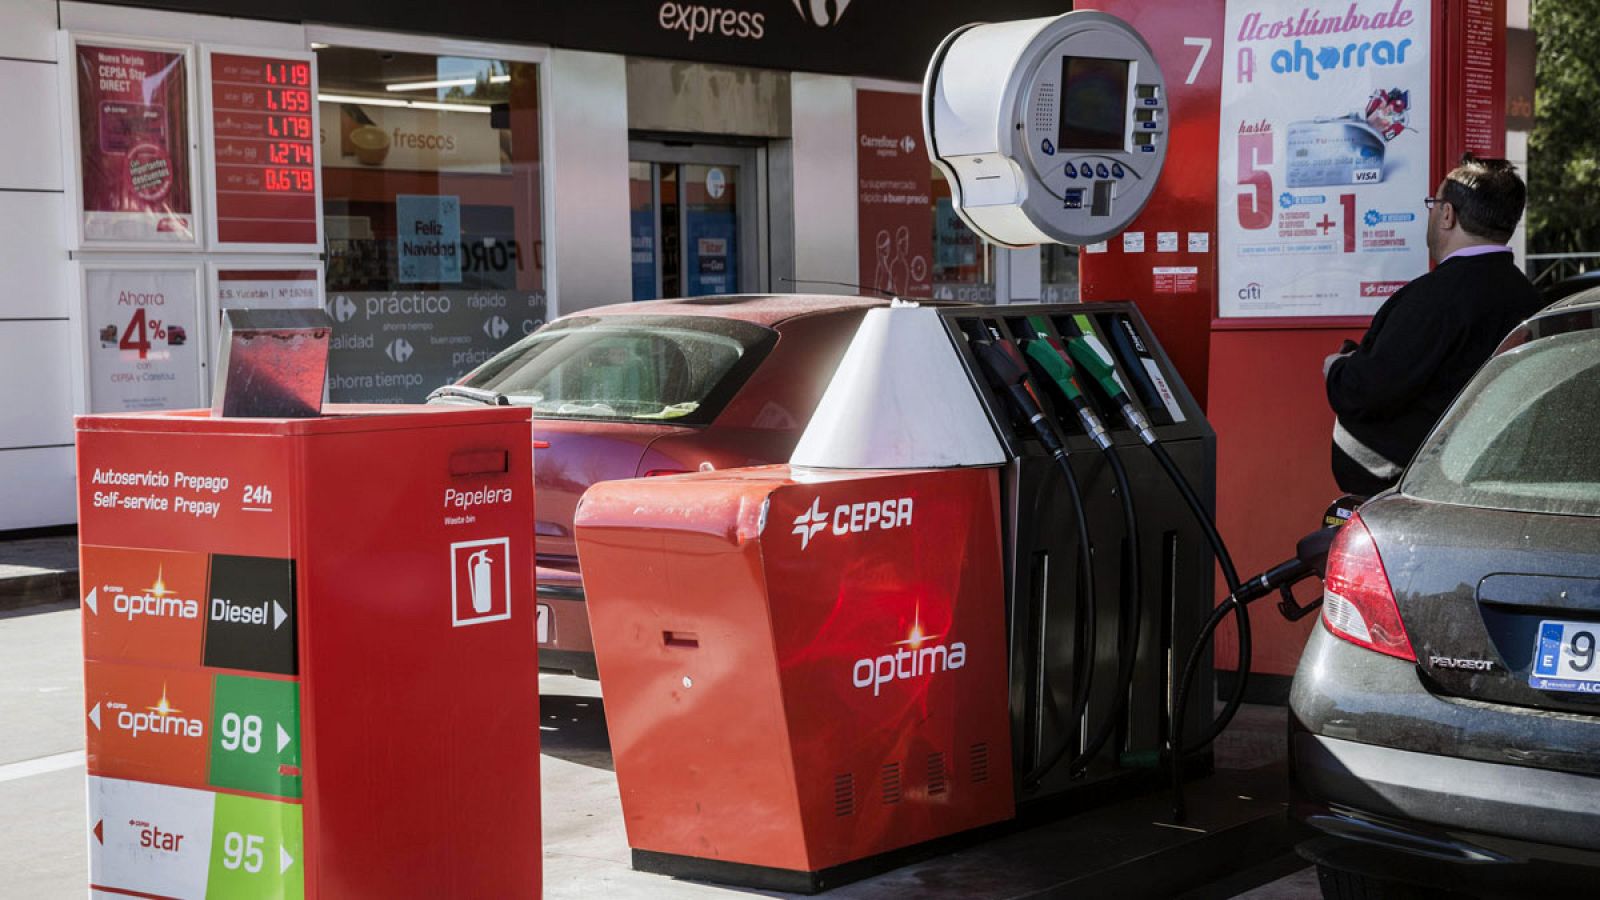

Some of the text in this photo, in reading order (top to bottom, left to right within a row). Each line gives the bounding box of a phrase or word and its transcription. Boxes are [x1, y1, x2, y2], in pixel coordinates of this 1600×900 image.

[659, 2, 765, 41] express
[1236, 0, 1414, 42] Acostúmbrate
[121, 54, 144, 66] Tarjeta
[1183, 36, 1213, 85] 7
[1237, 46, 1254, 83] A
[99, 65, 146, 80] CEPSA Star
[99, 79, 131, 92] DIRECT
[1237, 118, 1272, 134] hasta
[392, 127, 456, 150] frescos
[860, 134, 898, 148] Carrefour
[1237, 134, 1273, 230] 5
[1355, 171, 1378, 181] VISA
[888, 193, 906, 203] buen
[906, 193, 929, 205] precio
[415, 220, 444, 236] Feliz
[403, 240, 456, 257] Navidad
[117, 290, 165, 306] Ahorra
[236, 287, 270, 298] Yucatán
[1238, 284, 1261, 300] citi
[1376, 285, 1404, 293] CEPS
[365, 291, 452, 320] práctico
[466, 292, 507, 311] rápido
[382, 321, 434, 332] ahorra tiempo
[136, 361, 151, 370] con
[111, 373, 135, 383] CEPSA
[328, 371, 424, 390] ahorra tiempo
[92, 468, 229, 494] Autoservicio Prepago
[93, 491, 220, 518] Self-service Prepay
[242, 485, 272, 505] 24h
[444, 485, 513, 511] Papelera
[444, 515, 476, 526] Waste bin
[832, 497, 913, 536] CEPSA
[113, 592, 199, 621] optima
[211, 598, 269, 625] Diesel
[1543, 630, 1597, 672] E 9
[852, 641, 967, 697] optima
[1429, 656, 1495, 671] PEUGEOT
[118, 711, 203, 738] optima
[221, 711, 263, 754] 98
[139, 826, 185, 852] star
[223, 831, 265, 873] 95
